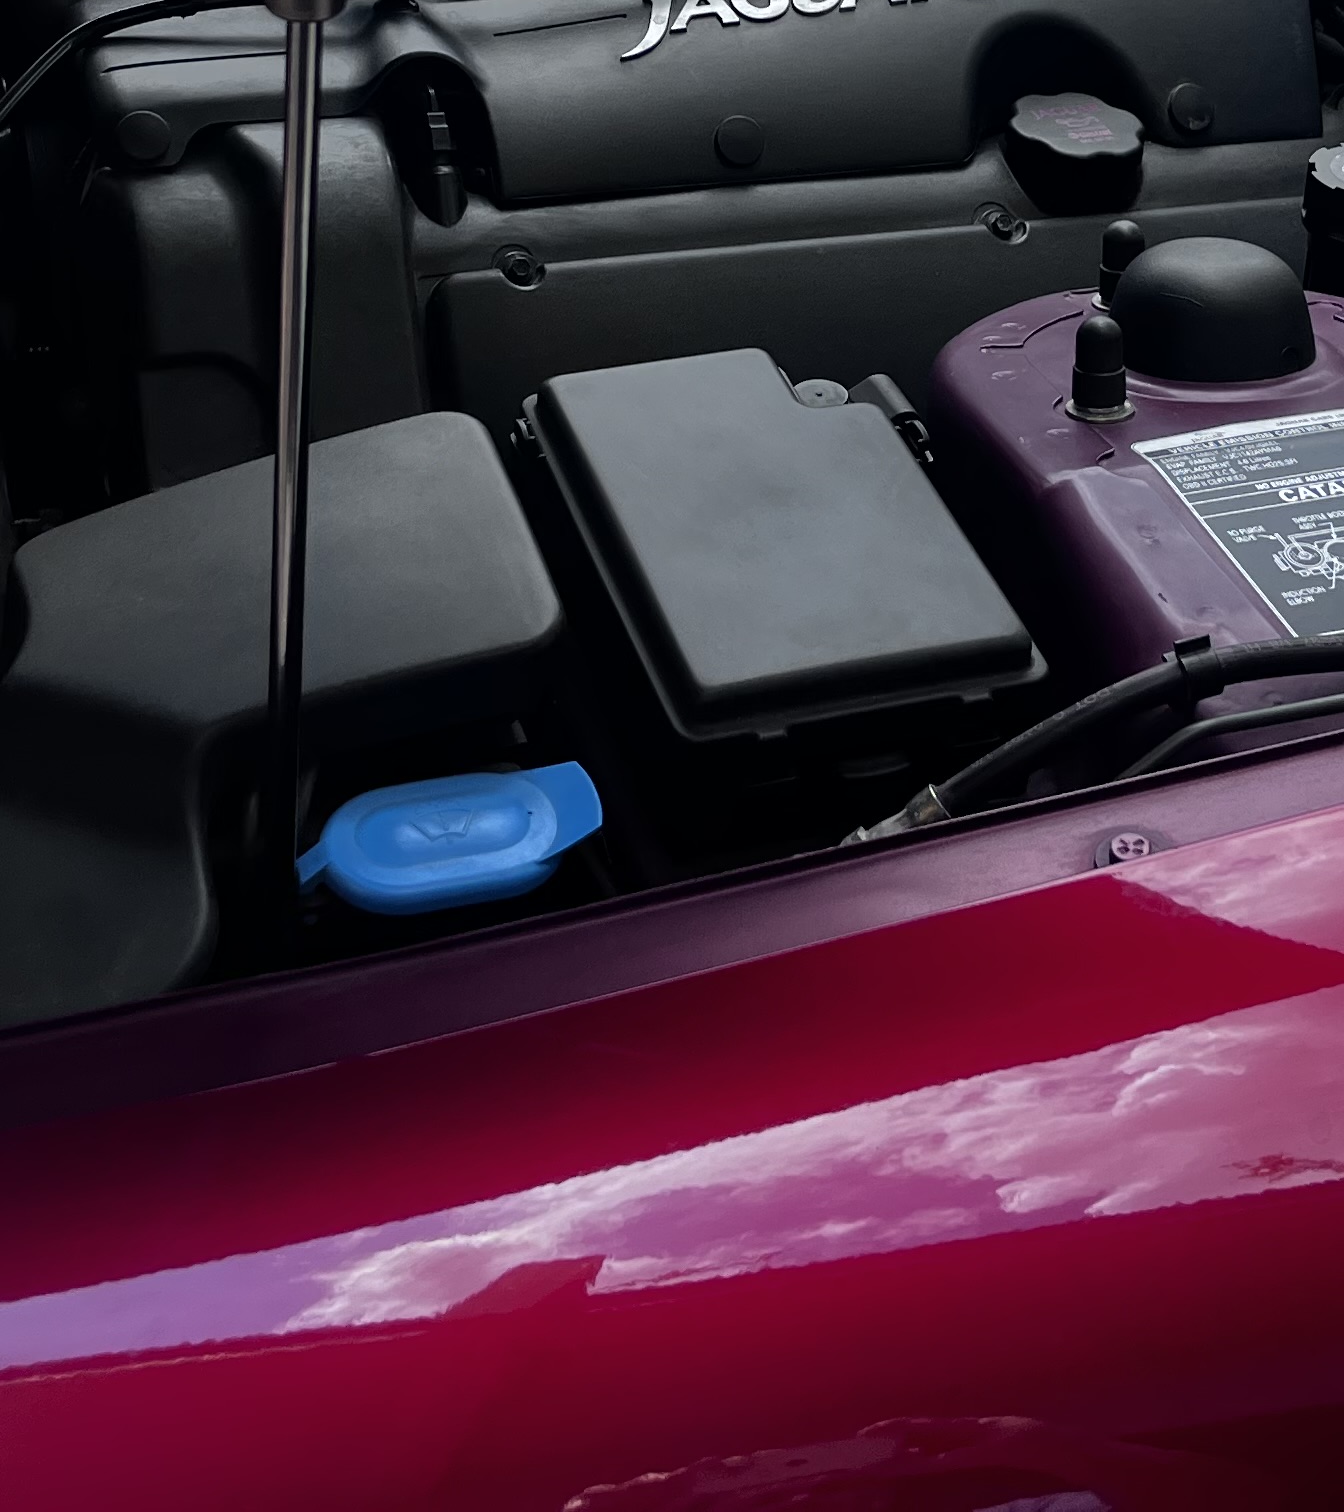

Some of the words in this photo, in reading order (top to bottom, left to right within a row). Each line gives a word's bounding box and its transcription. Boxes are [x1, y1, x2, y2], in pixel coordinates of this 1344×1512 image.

[1168, 441, 1217, 453] VEHICLE
[1217, 432, 1274, 445] EMISSION
[1274, 424, 1327, 436] CONTROL
[1255, 482, 1270, 490] NO
[1269, 477, 1303, 487] ENGINE
